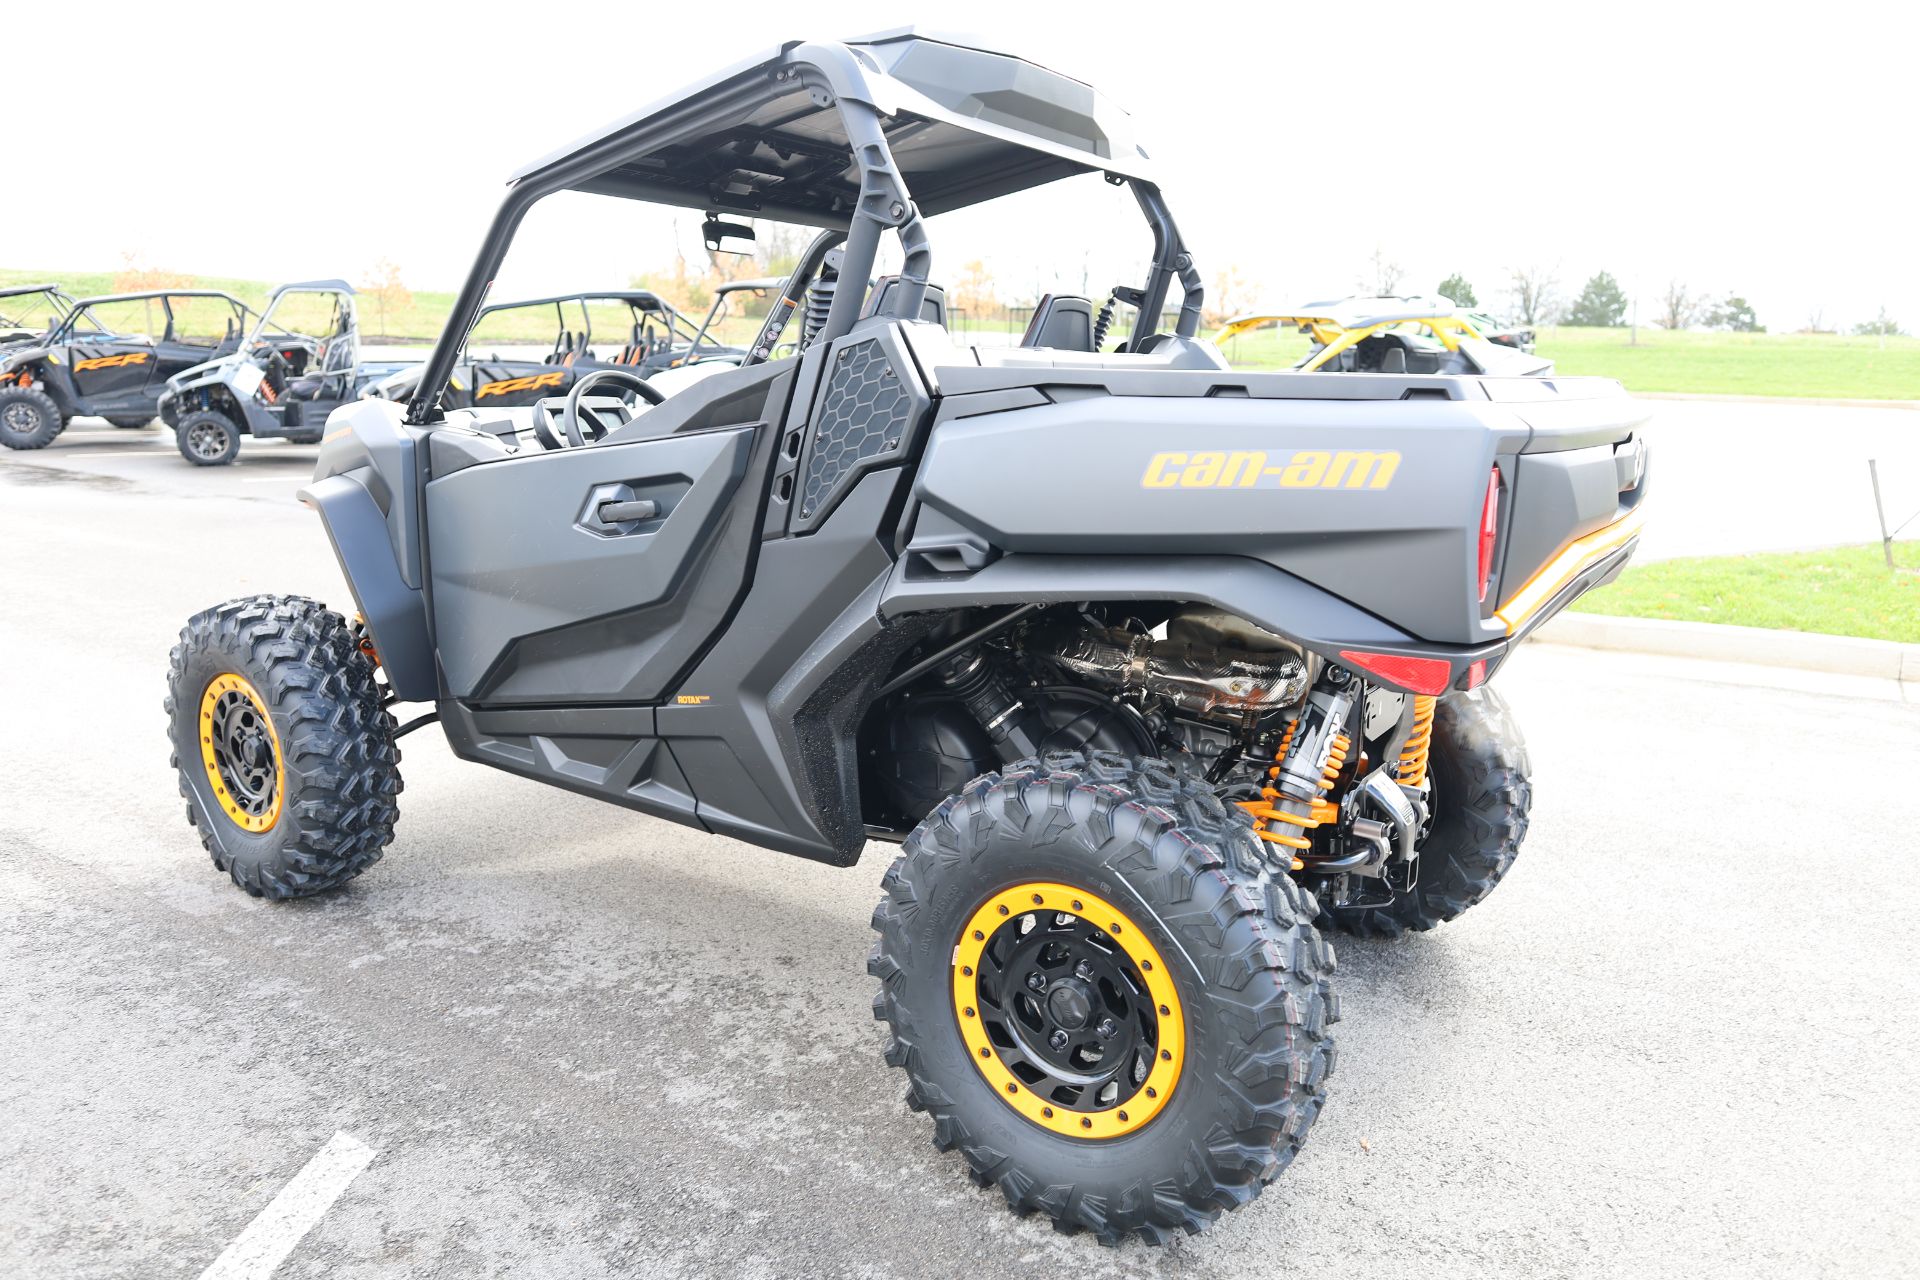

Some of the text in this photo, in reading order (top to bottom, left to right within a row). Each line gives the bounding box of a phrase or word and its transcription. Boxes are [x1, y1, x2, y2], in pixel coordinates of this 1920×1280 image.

[74, 352, 148, 373] RZR
[476, 371, 565, 399] RZR
[1141, 450, 1402, 490] can-am
